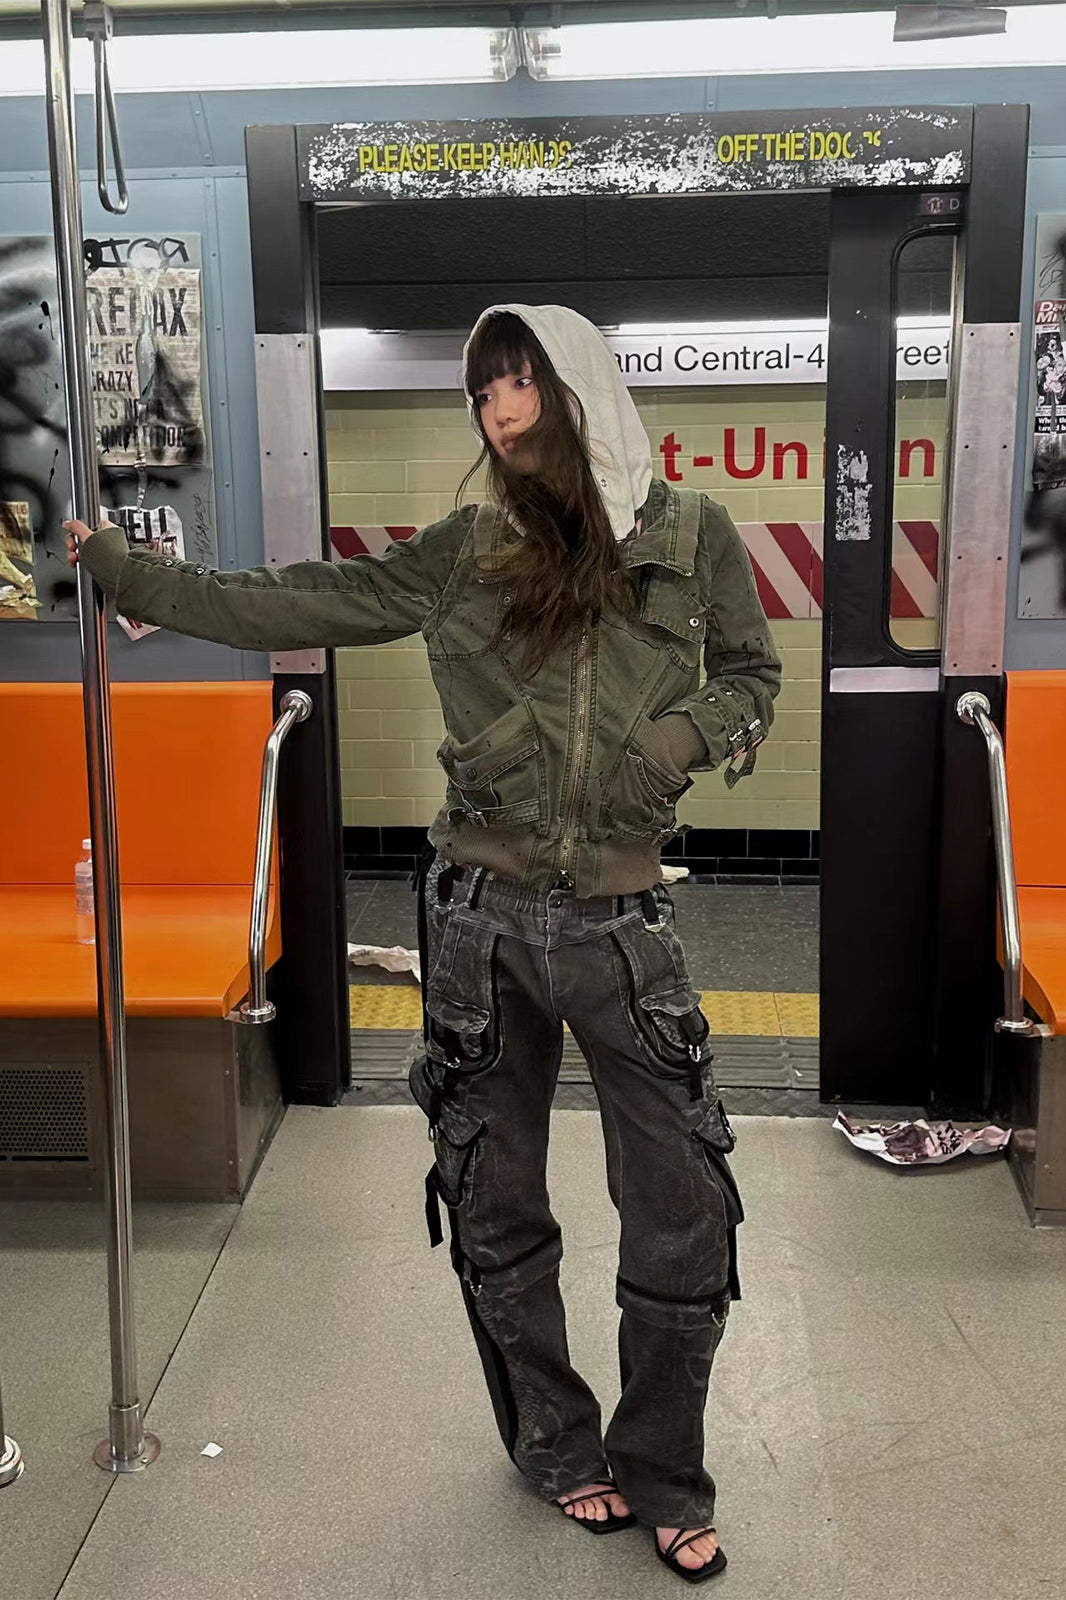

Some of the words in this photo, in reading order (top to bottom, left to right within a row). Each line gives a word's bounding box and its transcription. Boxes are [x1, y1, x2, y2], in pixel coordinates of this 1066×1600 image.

[360, 144, 440, 172] PLEASE
[443, 142, 495, 170] KEEP
[717, 134, 759, 163] OFF
[762, 132, 805, 161] THE
[85, 287, 188, 336] RELAX
[674, 343, 826, 372] Central-4
[94, 397, 118, 420] T'S
